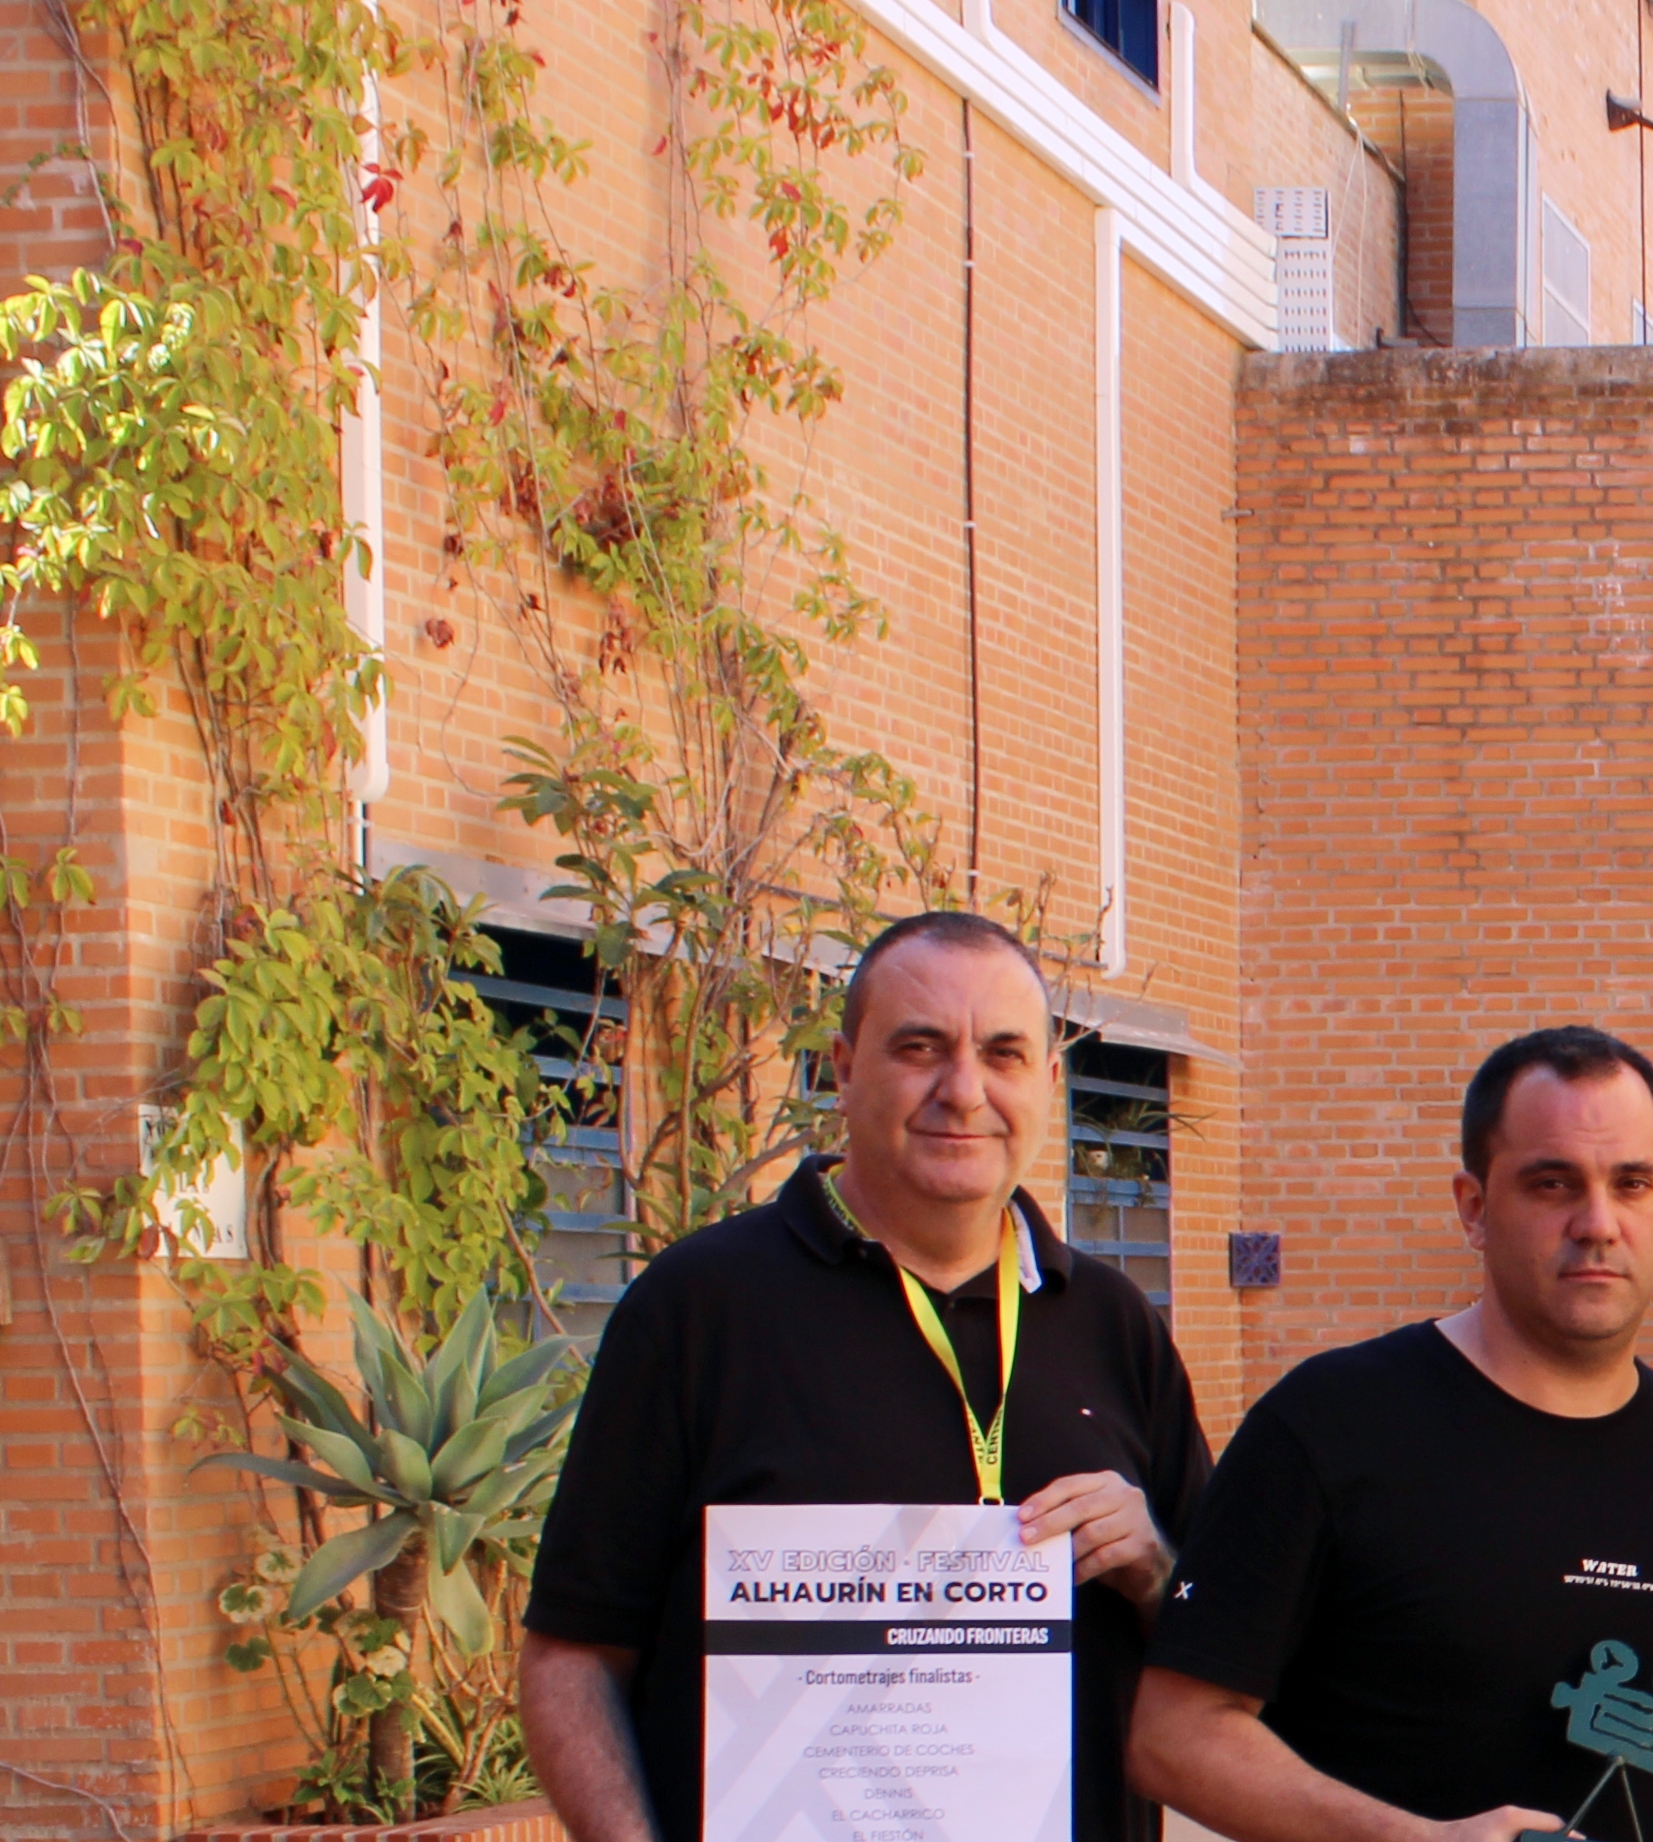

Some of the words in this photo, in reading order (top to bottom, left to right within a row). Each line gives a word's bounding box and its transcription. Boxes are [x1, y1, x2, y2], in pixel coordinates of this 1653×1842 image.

[728, 1550, 773, 1572] XV
[782, 1545, 896, 1572] EDICIÓN
[918, 1549, 1049, 1572] FESTIVAL
[1581, 1558, 1639, 1577] WATER
[730, 1576, 886, 1602] ALHAURÍN
[897, 1582, 933, 1602] EN
[943, 1582, 1048, 1602] CORTO
[886, 1628, 964, 1645] CRUZANDO
[965, 1628, 1048, 1645] FRONTERAS
[806, 1669, 906, 1687] Cortometrajes
[909, 1668, 973, 1684] finalistas
[847, 1703, 932, 1714] AMARRADAS
[911, 1723, 948, 1735] ROJA
[803, 1746, 890, 1758] CEMENTERIO
[894, 1745, 912, 1756] DE
[915, 1744, 975, 1756] COCHES
[819, 1767, 900, 1779] CRECIENDO
[832, 1810, 846, 1822] EL
[852, 1830, 866, 1842] EL
